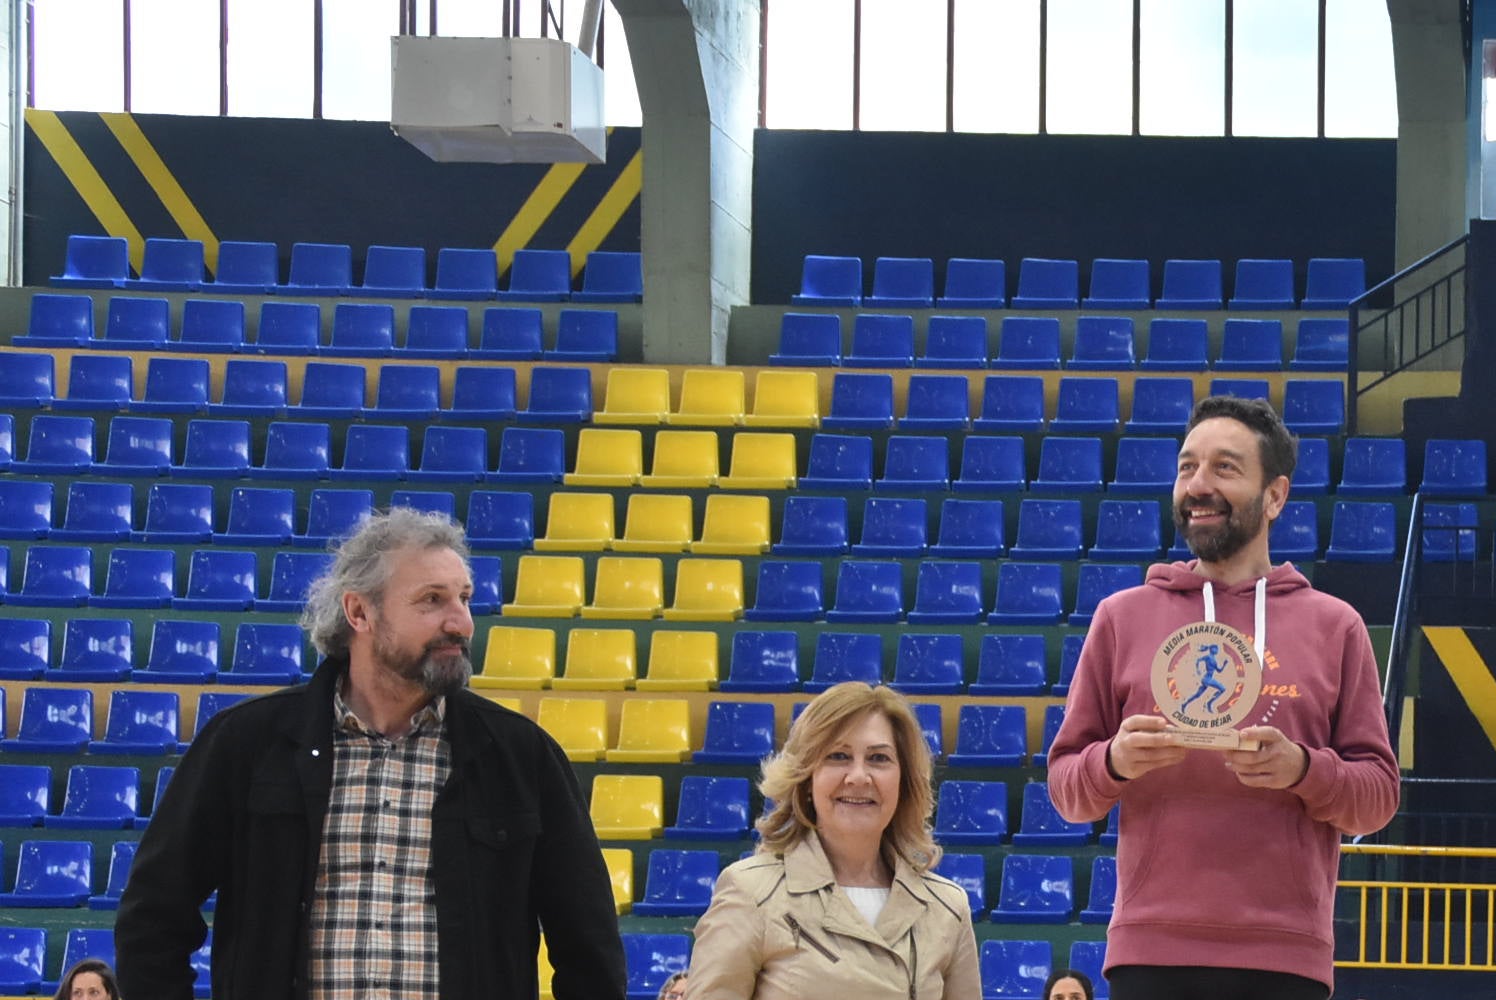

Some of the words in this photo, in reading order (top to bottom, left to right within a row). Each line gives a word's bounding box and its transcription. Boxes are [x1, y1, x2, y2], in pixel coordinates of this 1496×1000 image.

[1163, 633, 1185, 656] MEDIA
[1185, 625, 1226, 637] MARATÓN
[1226, 632, 1253, 664] POPULAR
[1171, 710, 1199, 728] CIUDAD
[1199, 721, 1209, 729] DE
[1210, 713, 1232, 728] BÉJAR
